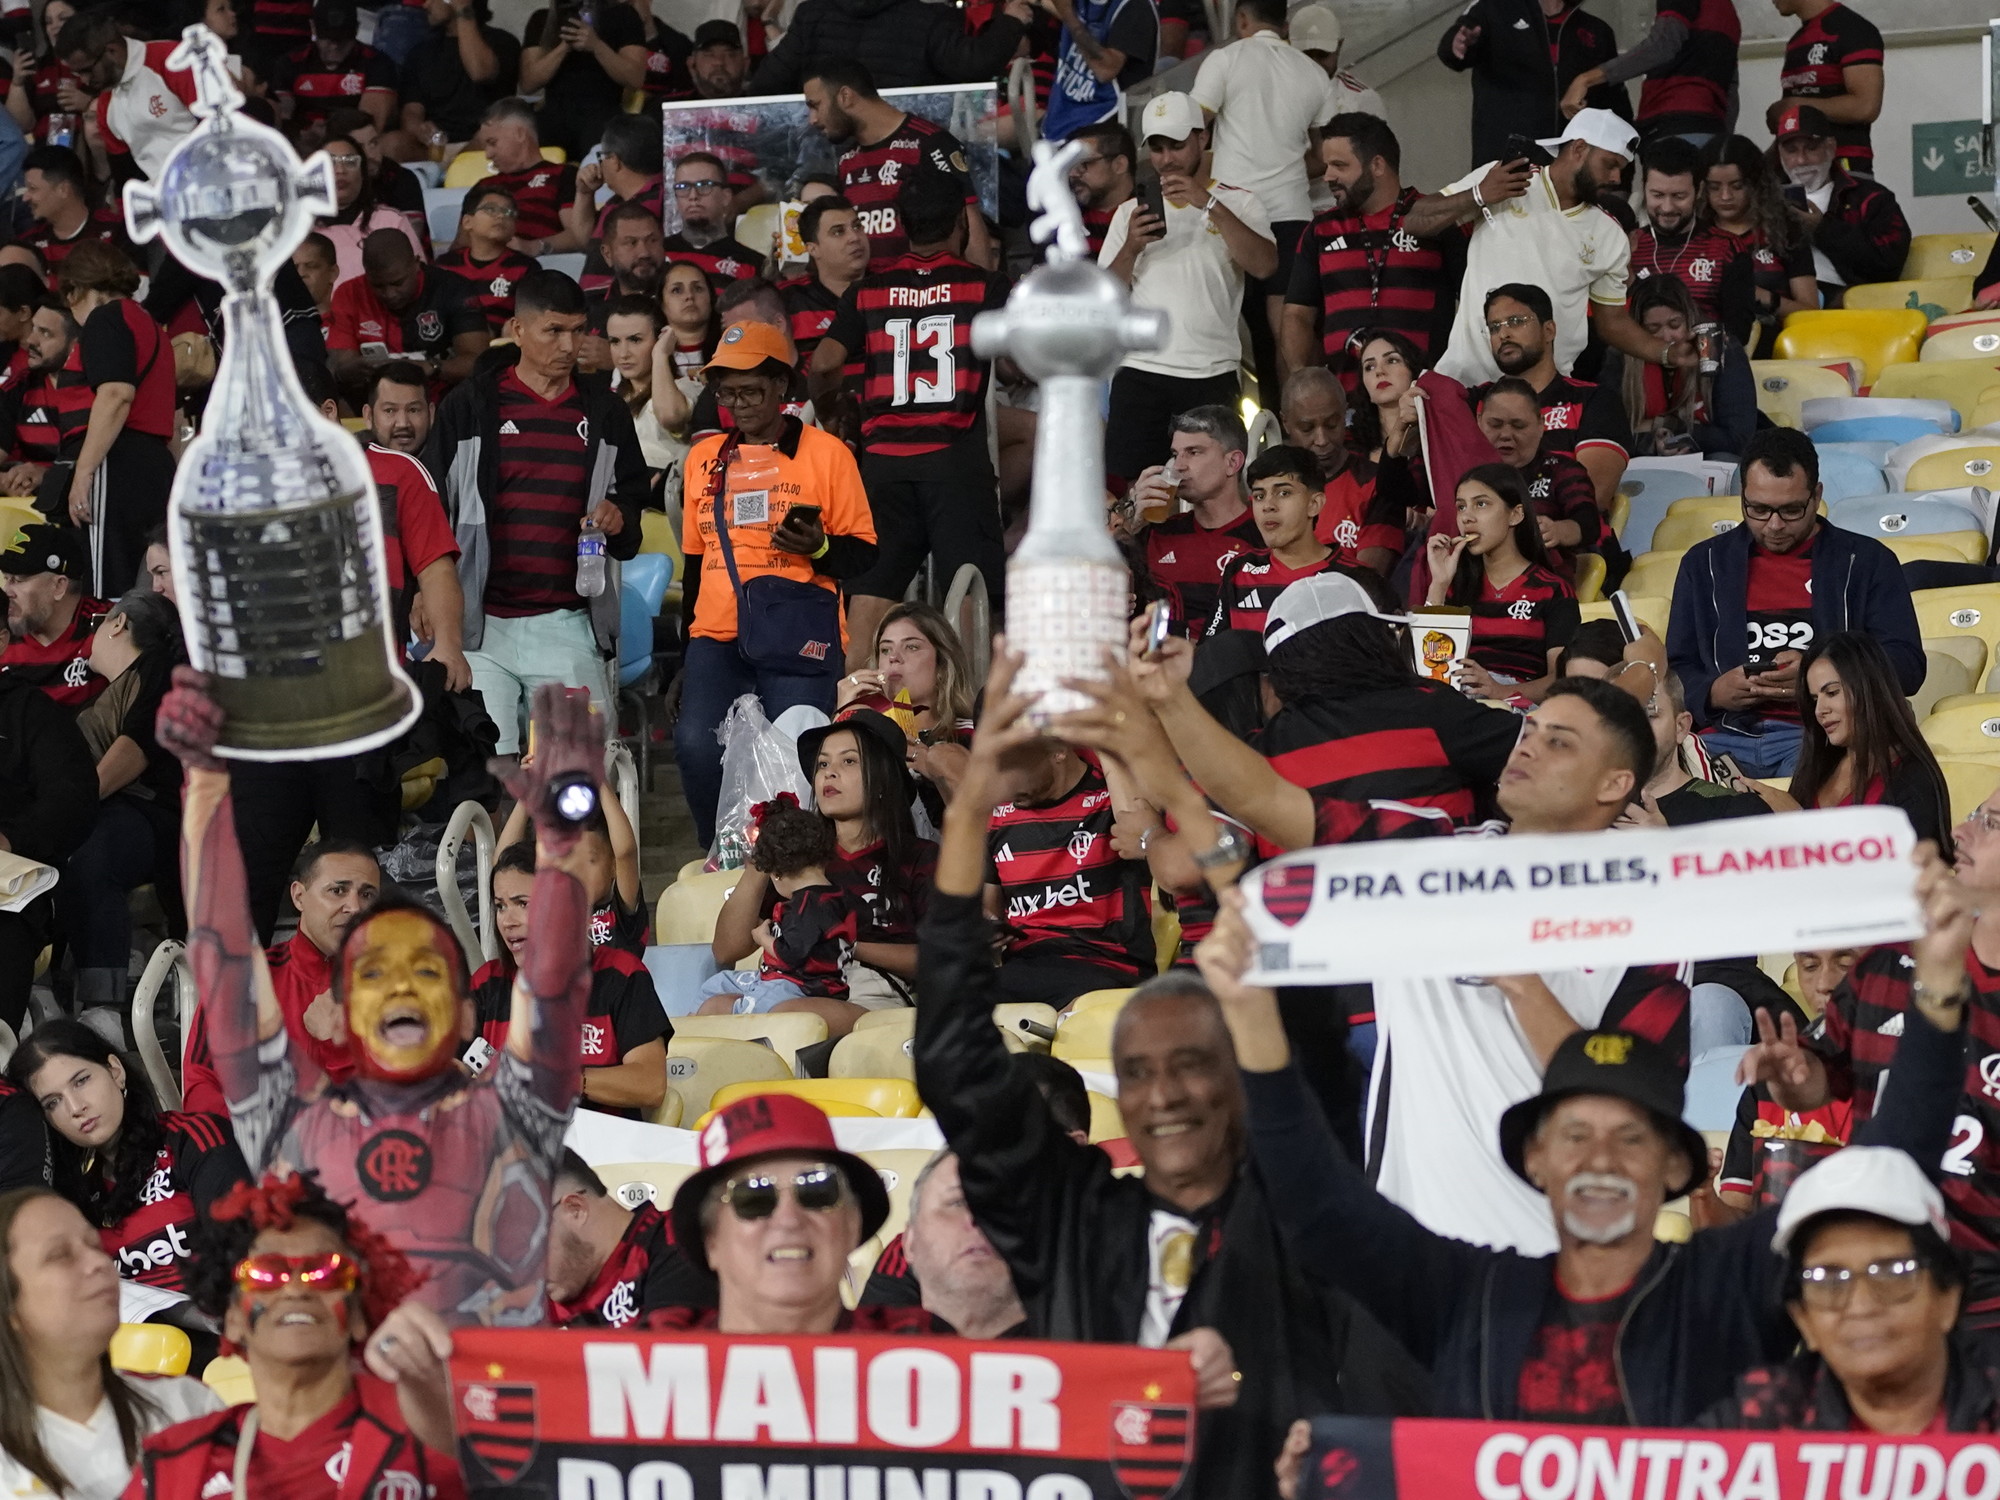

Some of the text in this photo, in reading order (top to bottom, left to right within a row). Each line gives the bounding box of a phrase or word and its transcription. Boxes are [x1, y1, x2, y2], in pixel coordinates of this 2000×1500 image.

[889, 283, 951, 308] FRANCIS
[884, 314, 956, 407] 13
[1973, 462, 1986, 472] 04
[1887, 519, 1900, 528] 04
[1958, 614, 1972, 623] 05
[1328, 835, 1897, 901] PRA CIMA DELES, FLAMENGO!
[1530, 916, 1633, 943] Betano
[670, 1064, 685, 1075] 02
[628, 1189, 644, 1201] 03
[583, 1341, 1063, 1452] MAIOR
[557, 1457, 695, 1500] DO
[1474, 1432, 2000, 1500] CONTRA TUDO
